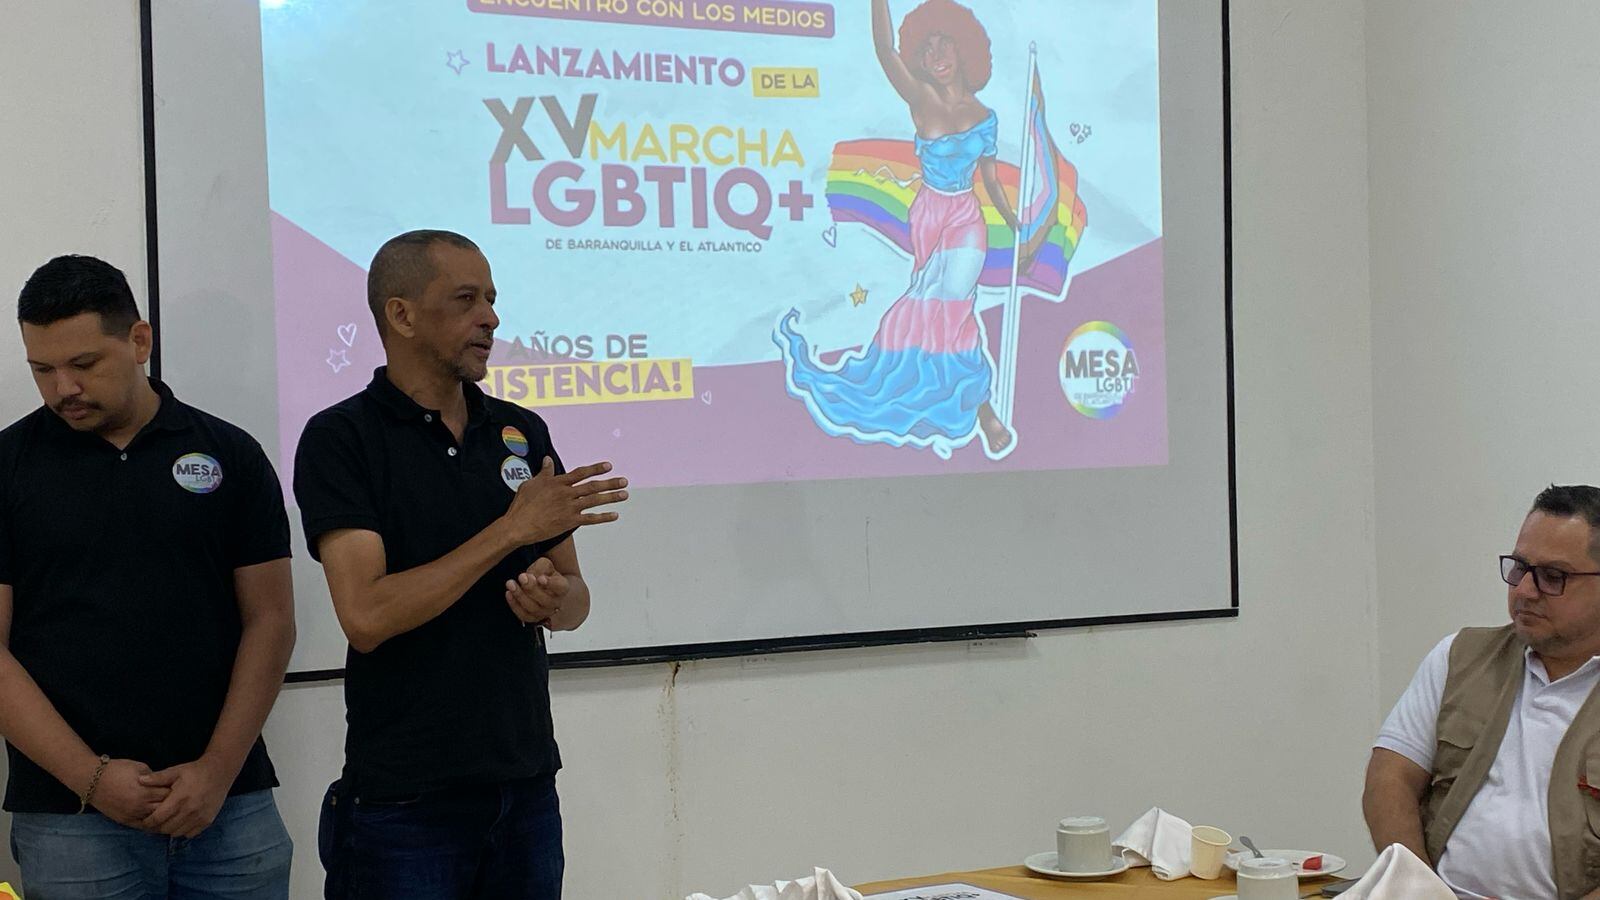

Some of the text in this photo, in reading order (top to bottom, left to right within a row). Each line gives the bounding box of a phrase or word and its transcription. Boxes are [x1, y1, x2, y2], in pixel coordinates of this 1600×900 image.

[636, 0, 684, 18] CON
[693, 1, 735, 22] LOS
[743, 6, 826, 29] MEDIOS
[486, 42, 745, 87] LANZAMIENTO
[761, 74, 815, 89] DE LA
[482, 93, 805, 168] XV MARCHA
[488, 161, 814, 241] LGBTIQ+
[545, 239, 763, 253] DE BARRANQUILLA Y EL ATLANTICO
[505, 331, 648, 360] AÑOS DE
[1065, 350, 1139, 378] MESA
[176, 463, 220, 477] MESA
